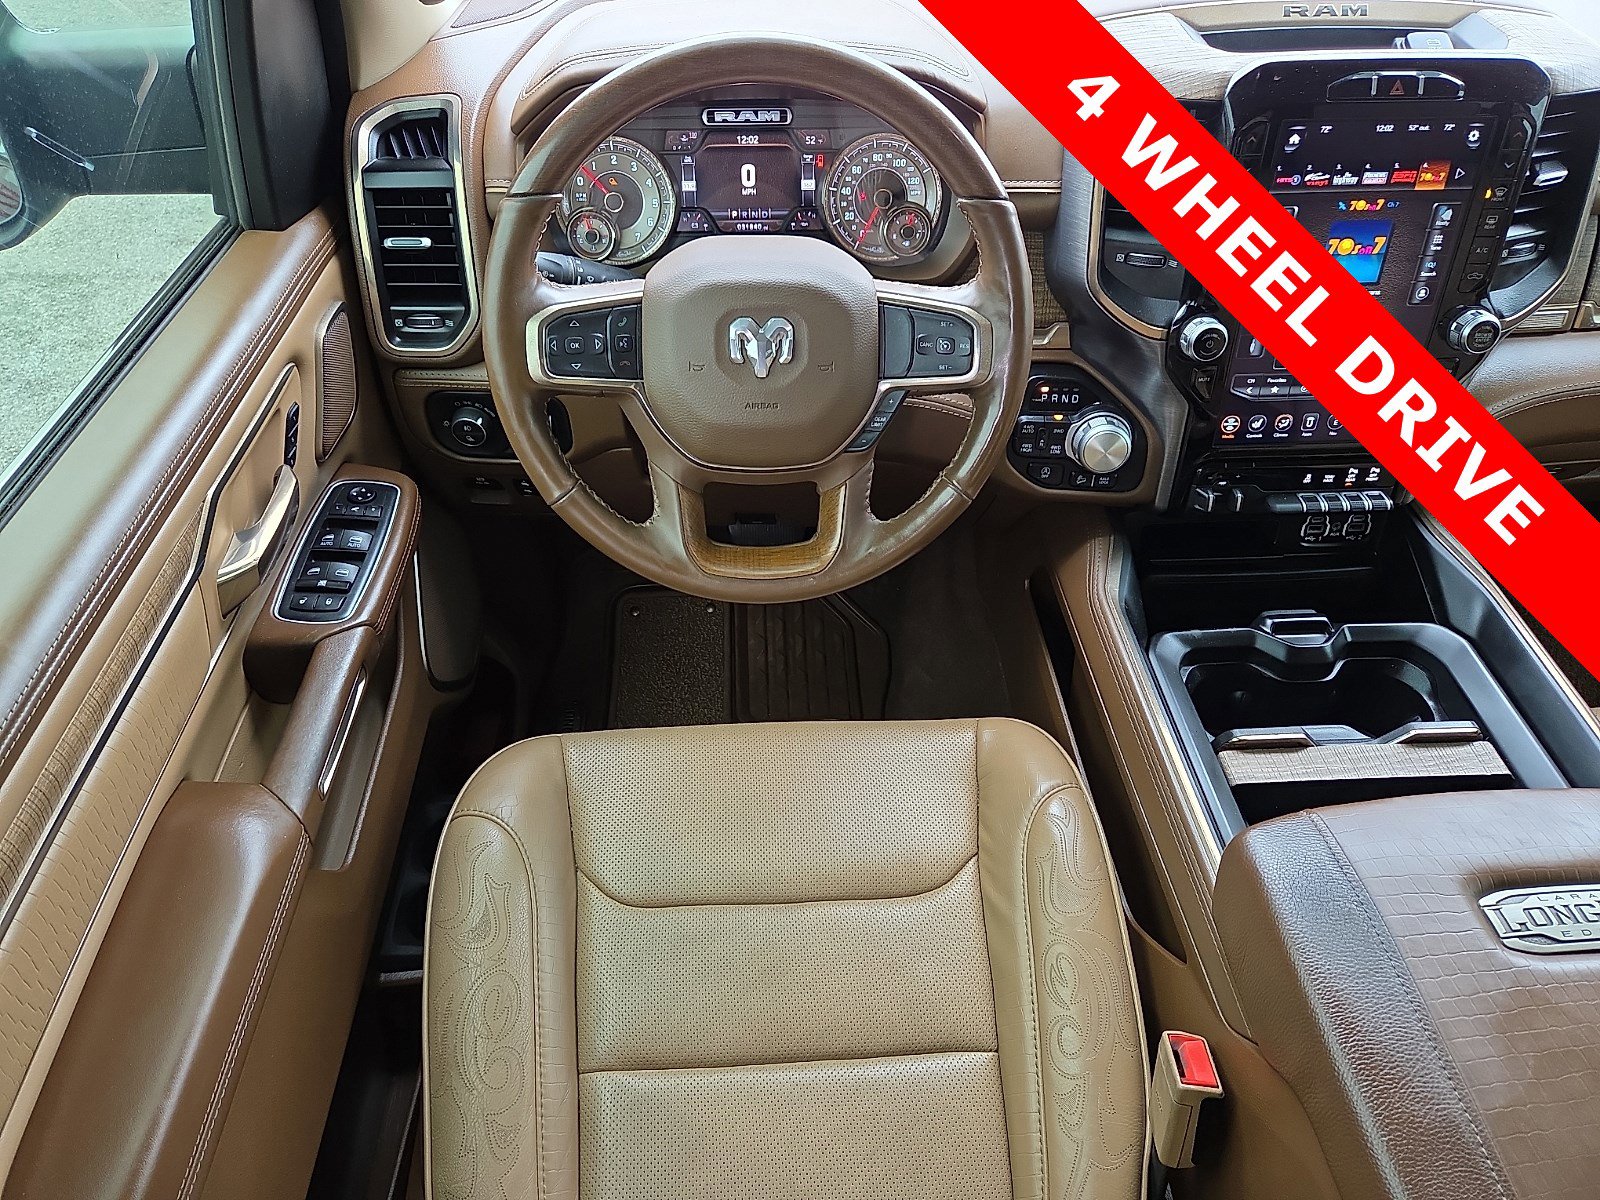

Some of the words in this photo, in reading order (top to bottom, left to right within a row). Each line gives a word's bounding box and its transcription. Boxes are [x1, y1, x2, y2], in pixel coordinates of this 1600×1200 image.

[1283, 4, 1368, 17] RAM
[714, 111, 781, 122] RAM
[1376, 124, 1395, 132] 12:02
[736, 135, 759, 144] 12:02
[805, 136, 816, 145] 52
[610, 155, 618, 165] 2
[872, 153, 883, 162] 80
[592, 161, 597, 171] 1
[630, 162, 638, 171] 3
[892, 159, 907, 167] 100
[851, 165, 862, 175] 60
[740, 163, 756, 188] 0
[576, 176, 584, 186] 0
[645, 178, 653, 187] 4
[907, 177, 920, 185] 120
[741, 188, 757, 196] MPH
[841, 187, 851, 195] 40
[844, 212, 855, 220] 20
[647, 217, 654, 226] 6
[634, 232, 641, 241] 7
[1041, 394, 1048, 403] P
[1051, 394, 1058, 403] R
[1061, 394, 1069, 403] N
[1071, 394, 1079, 404] D
[744, 402, 779, 410] AIRBAG
[1487, 903, 1600, 934] LONG
